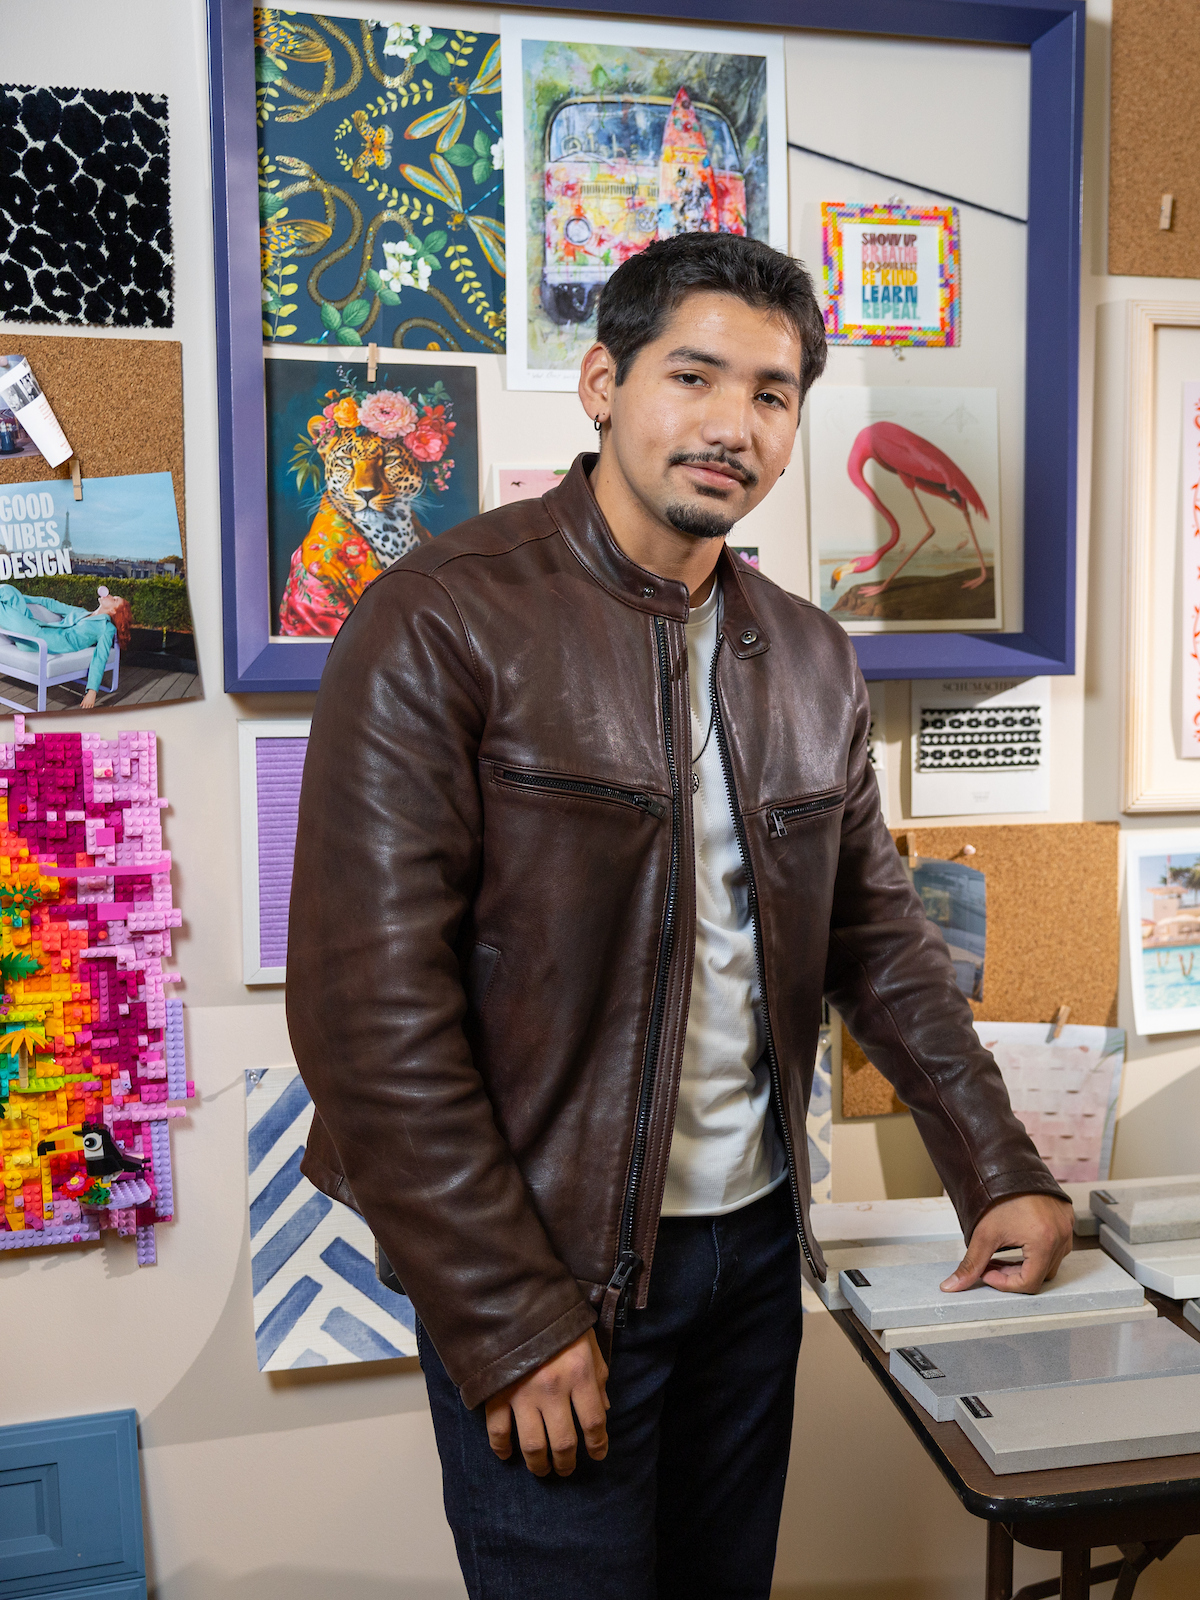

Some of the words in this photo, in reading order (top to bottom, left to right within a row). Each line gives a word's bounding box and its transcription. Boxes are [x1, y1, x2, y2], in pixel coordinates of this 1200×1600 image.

[861, 232, 901, 246] SHOW
[903, 233, 917, 247] UP
[861, 245, 918, 262] BREATHE
[862, 269, 876, 286] BE
[880, 269, 918, 286] KIND
[862, 285, 918, 303] LEARN
[0, 492, 54, 522] GOOD
[0, 520, 60, 551] VIBES
[0, 548, 72, 580] DESIGN
